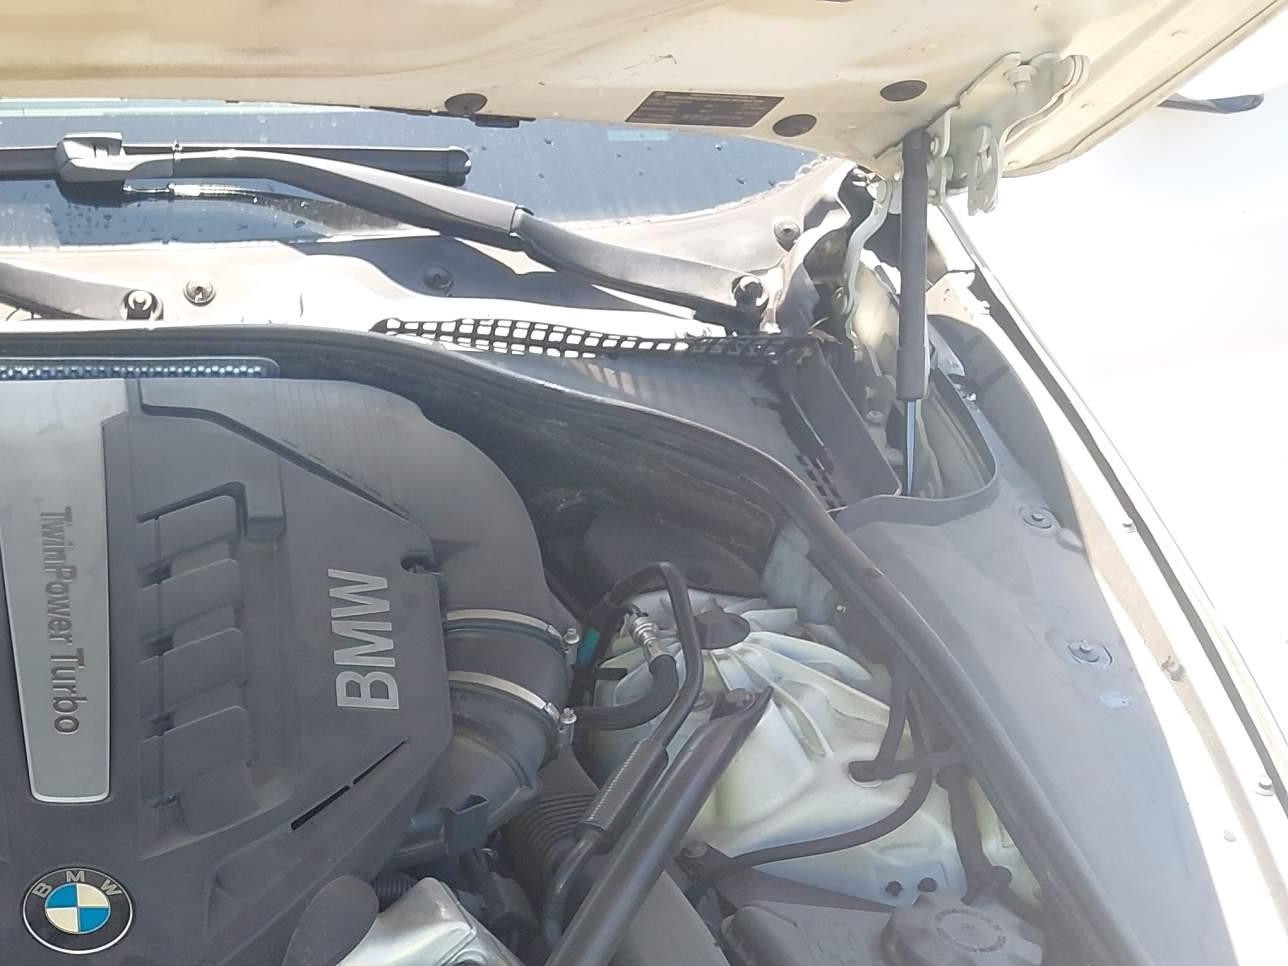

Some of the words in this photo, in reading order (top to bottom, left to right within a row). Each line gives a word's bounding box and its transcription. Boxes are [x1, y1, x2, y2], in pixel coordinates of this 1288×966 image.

[40, 506, 78, 646] TwinPower
[50, 648, 88, 736] Turbo
[327, 568, 400, 710] BMW
[31, 870, 123, 899] BMW
